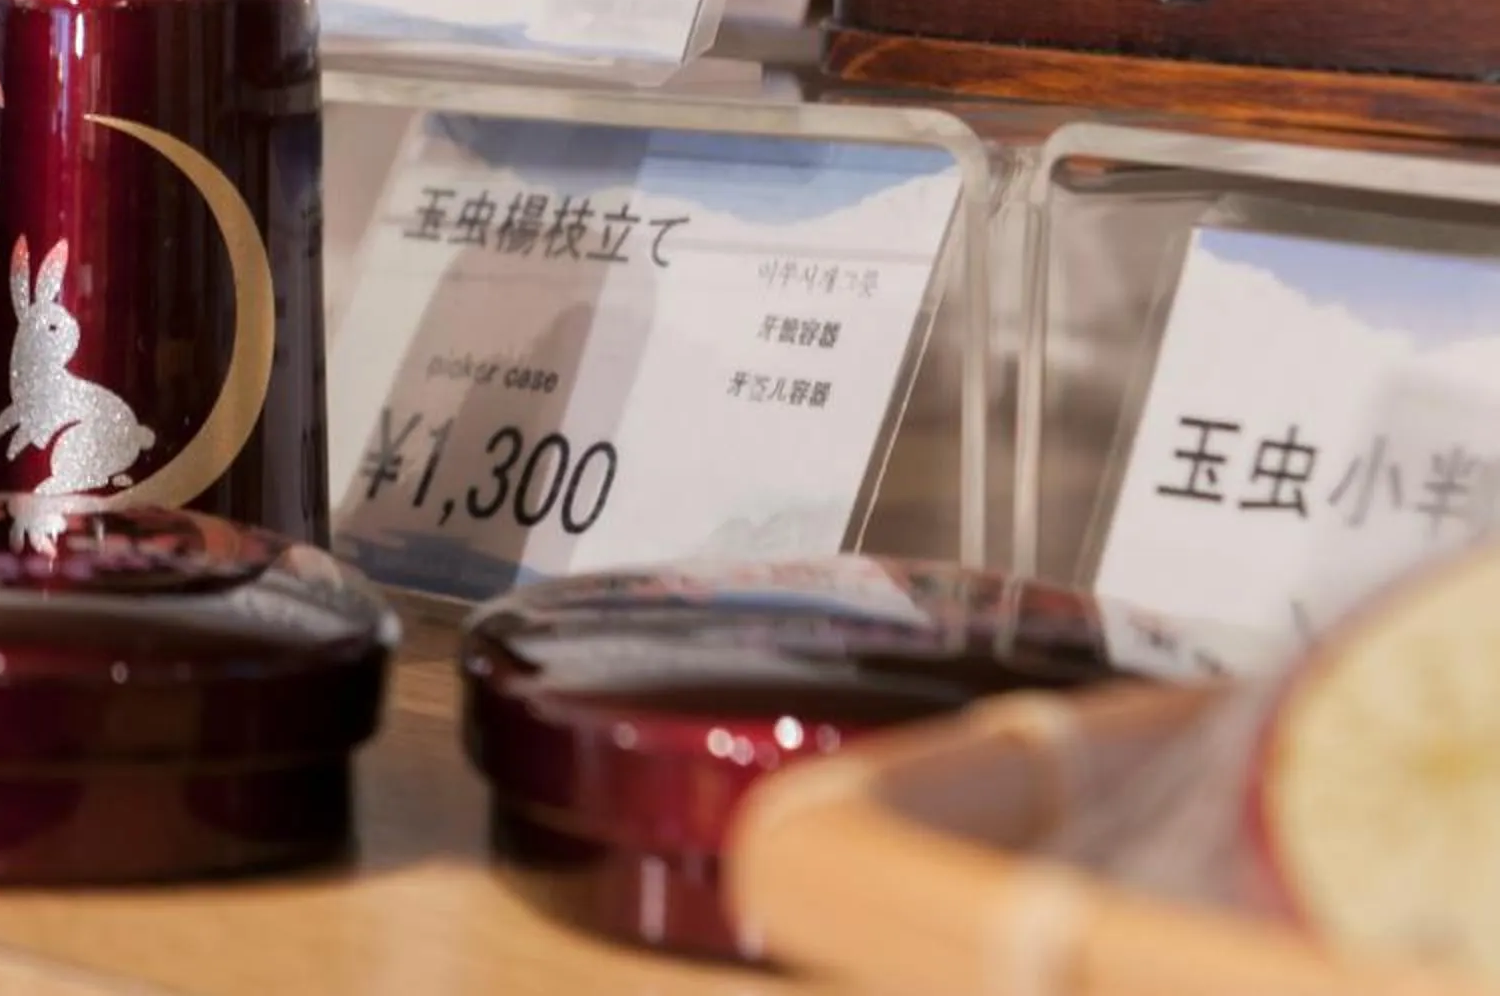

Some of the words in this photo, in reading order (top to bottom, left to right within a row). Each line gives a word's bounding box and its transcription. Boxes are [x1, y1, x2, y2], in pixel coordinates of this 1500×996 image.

[403, 187, 690, 268] 玉虫楊枝立て
[359, 405, 618, 535] ¥1,300
